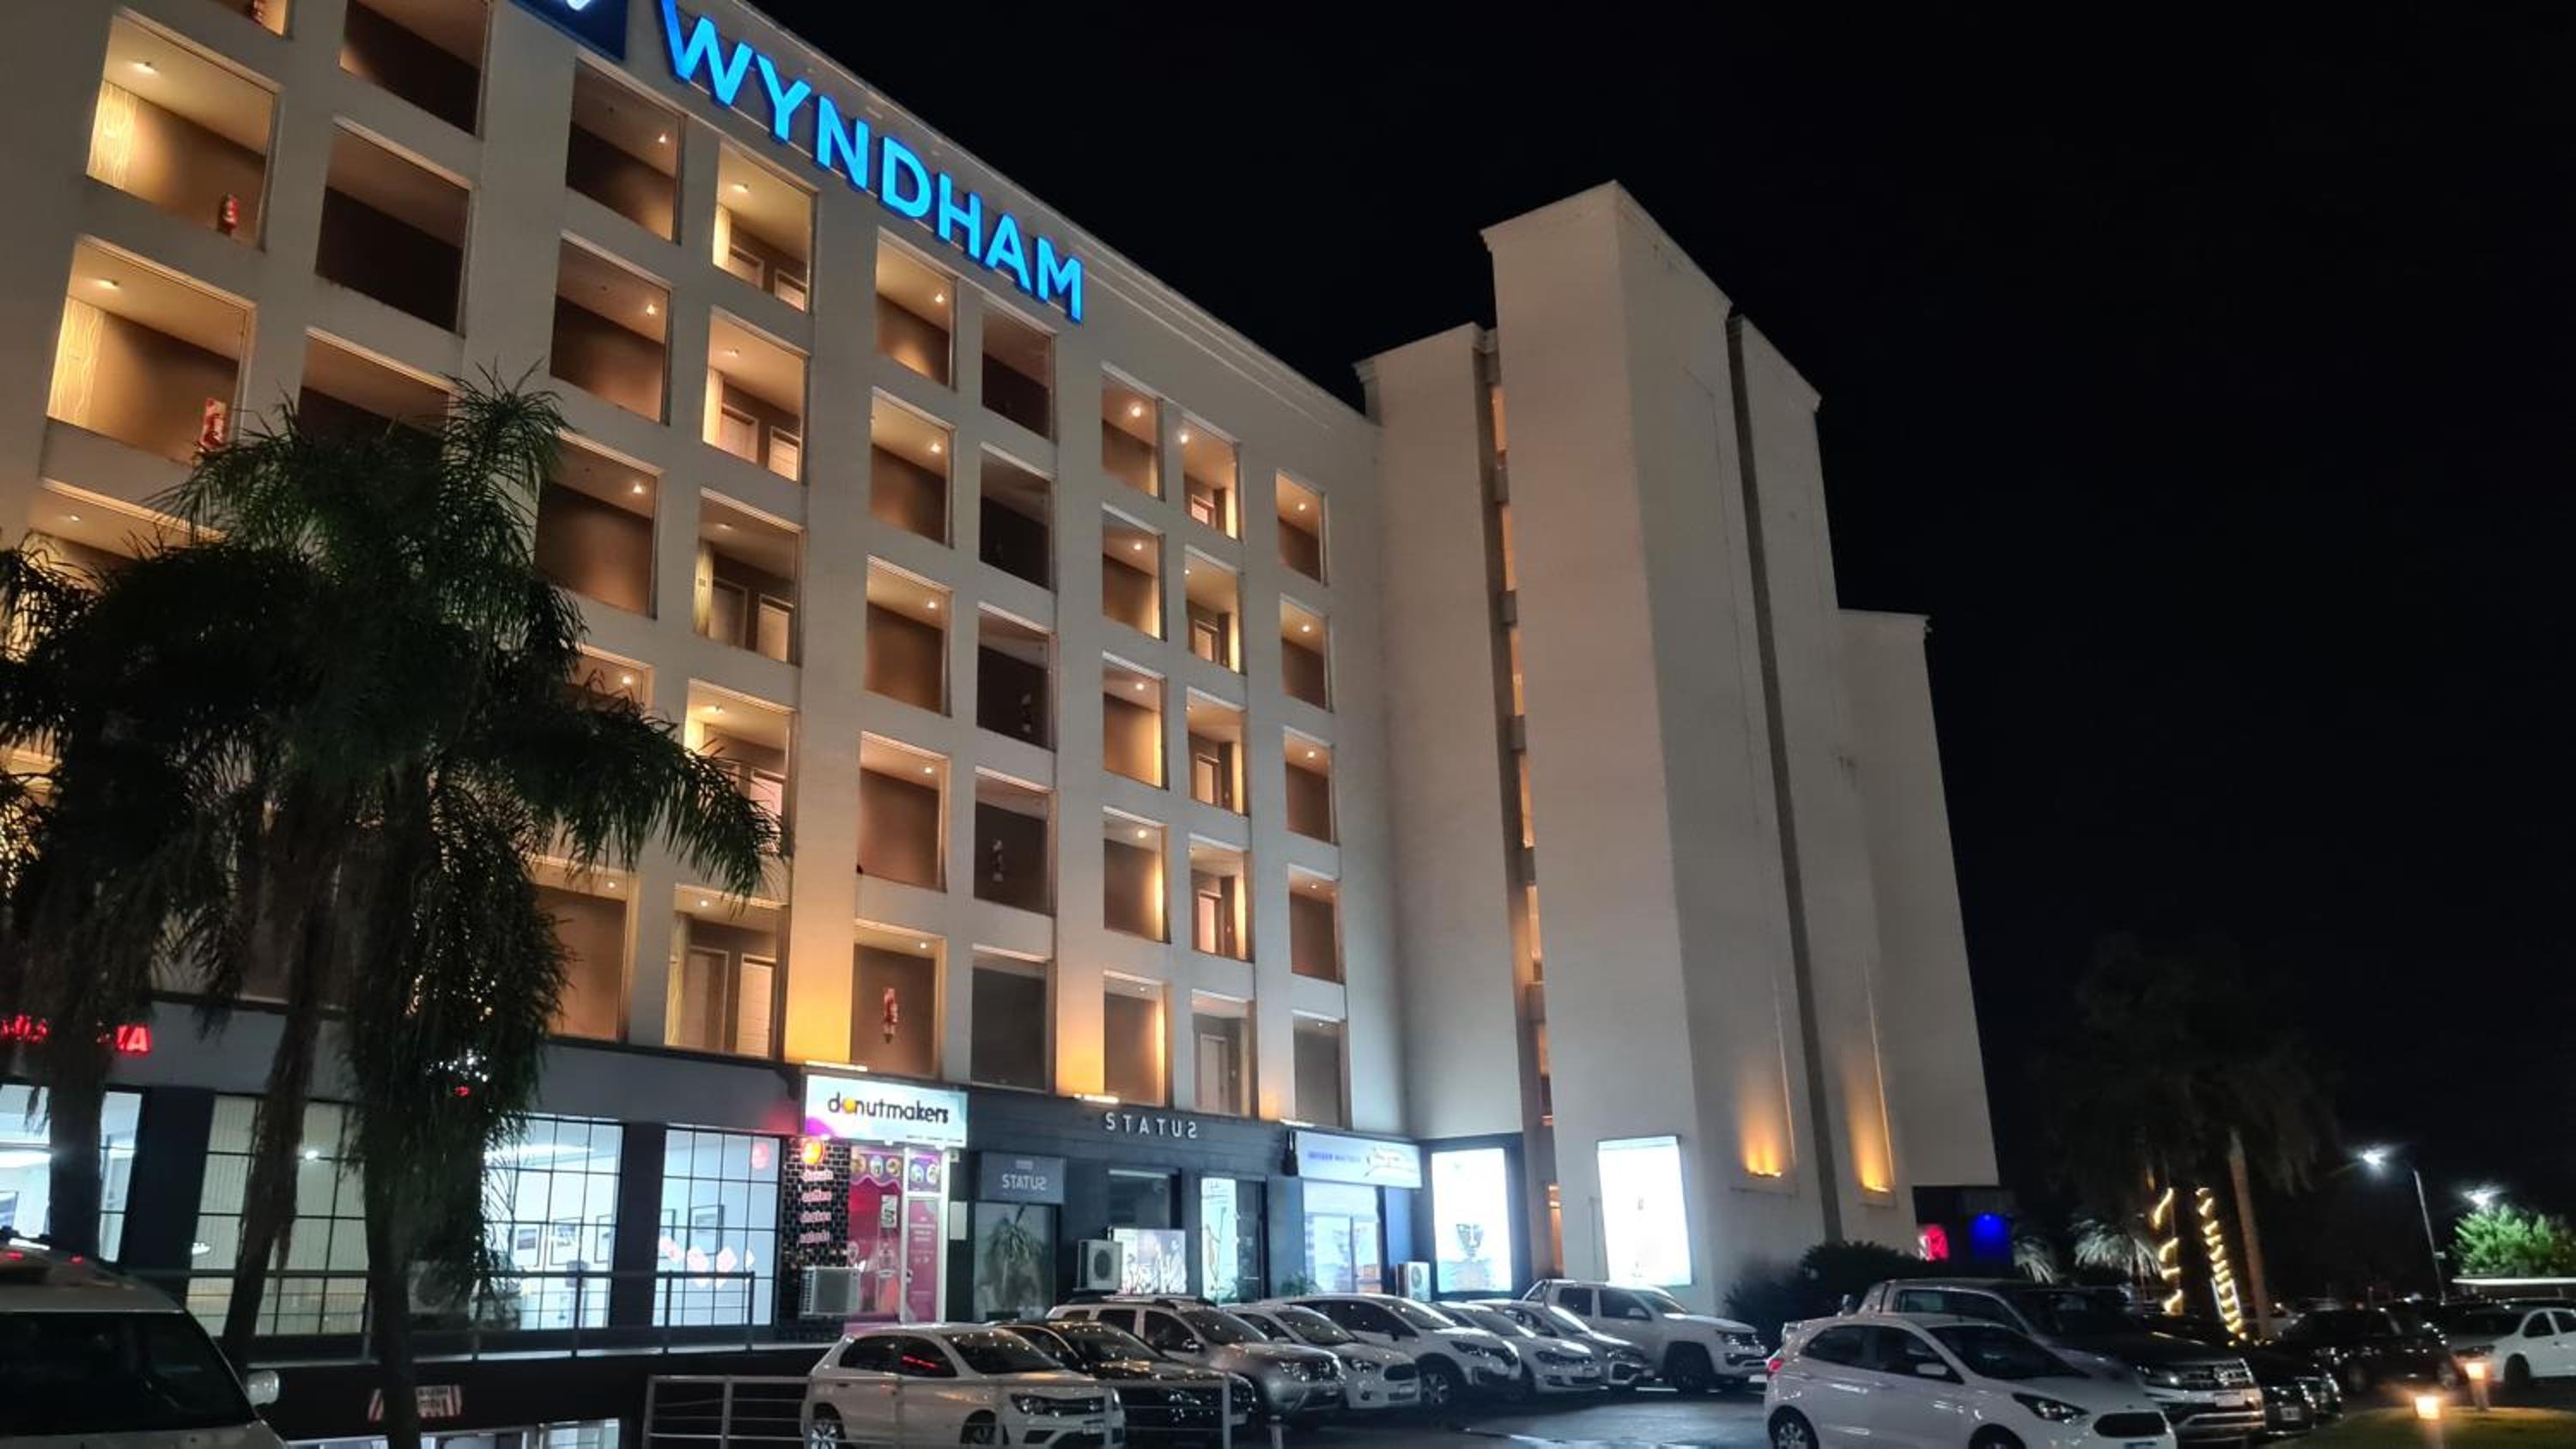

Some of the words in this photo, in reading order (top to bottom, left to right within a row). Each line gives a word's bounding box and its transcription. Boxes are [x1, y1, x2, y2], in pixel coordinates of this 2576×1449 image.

[659, 0, 1083, 324] WYNDHAM
[828, 1091, 950, 1124] donutmakers
[1104, 1112, 1199, 1139] STATUS
[1001, 1173, 1048, 1191] STATUS
